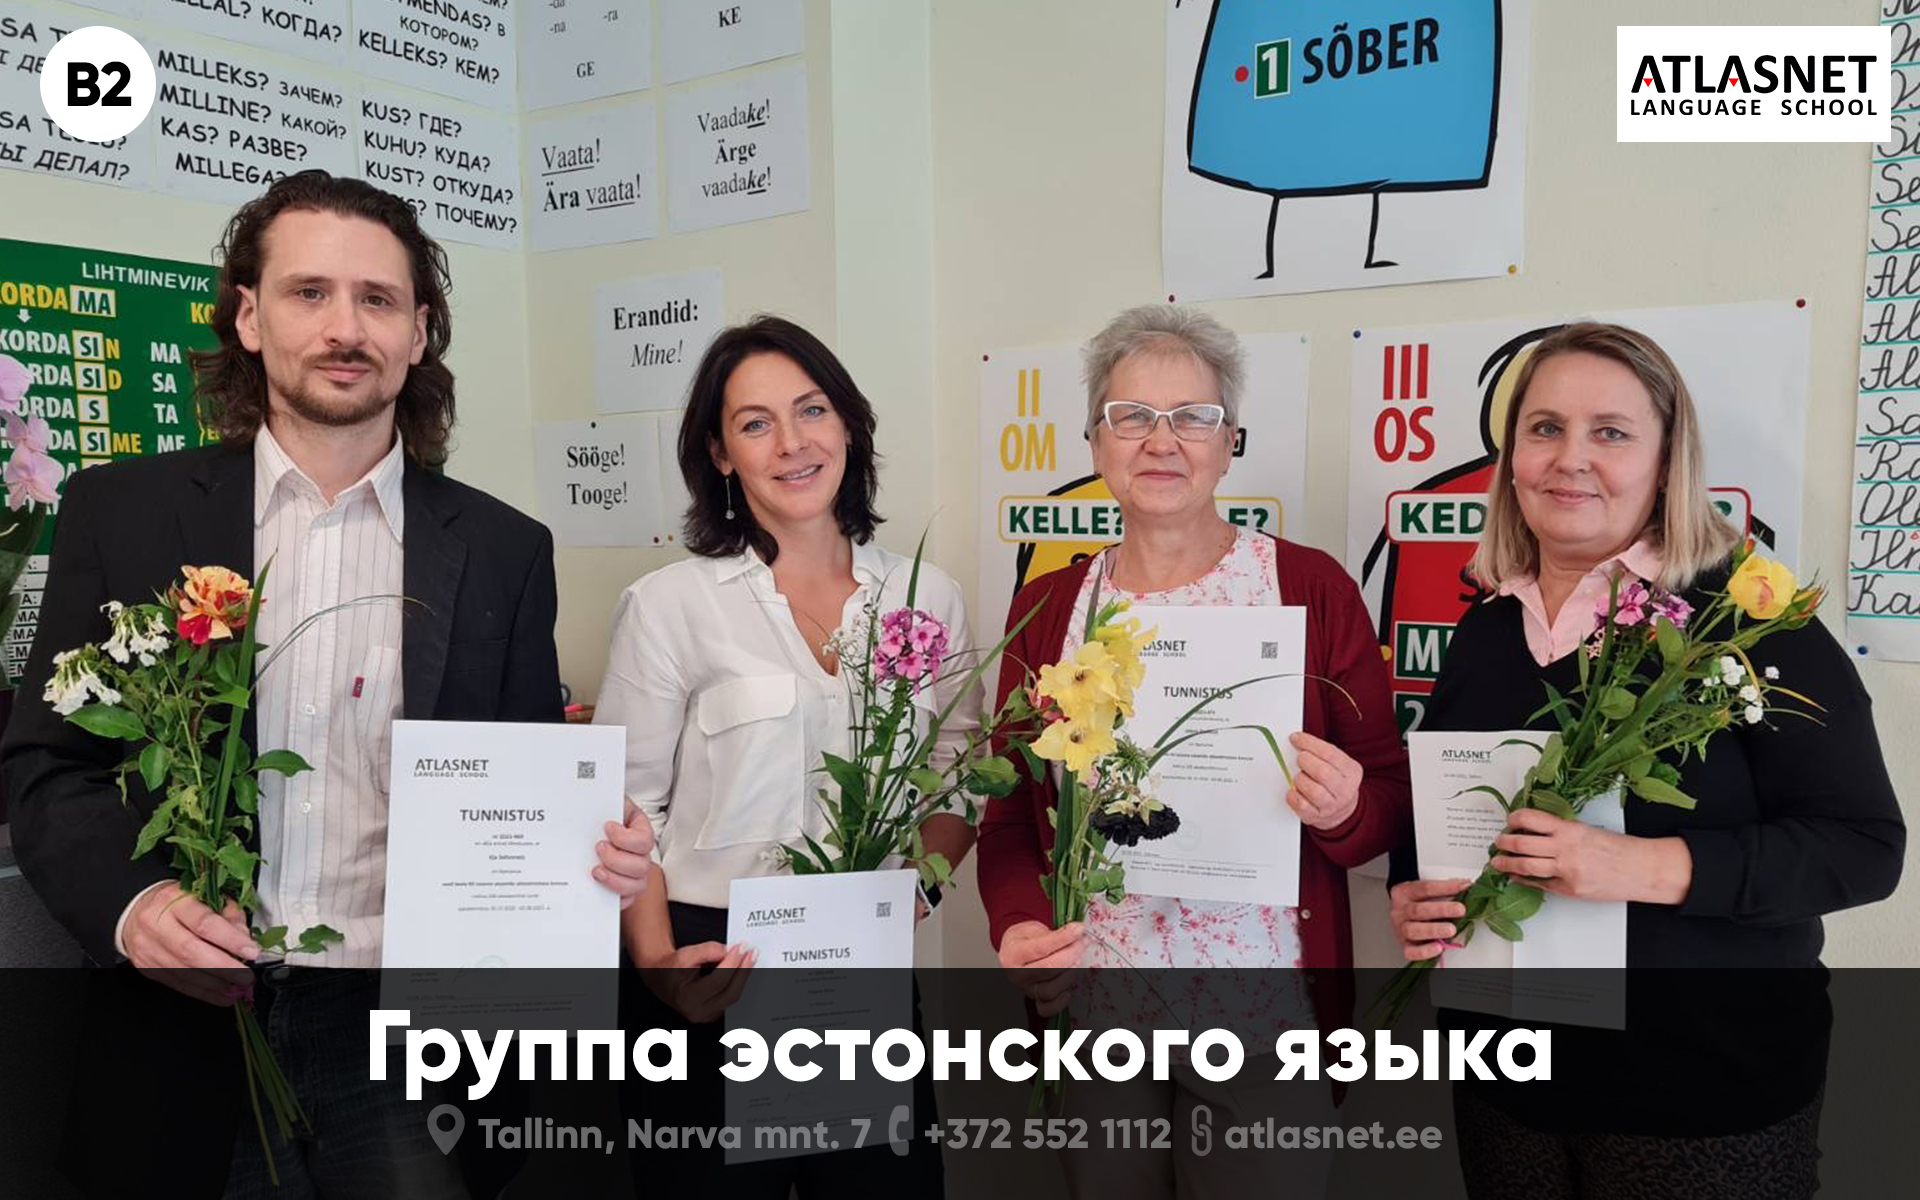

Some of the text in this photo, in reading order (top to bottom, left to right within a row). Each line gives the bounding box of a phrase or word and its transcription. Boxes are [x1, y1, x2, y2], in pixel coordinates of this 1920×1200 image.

[0, 18, 37, 42] SA
[262, 7, 342, 42] КОГДА?
[405, 0, 491, 31] MENDAS?
[718, 6, 742, 28] KE
[400, 16, 479, 51] КОТОРОМ?
[359, 30, 500, 84] KELLEKS? КЕМ?
[576, 61, 595, 78] GE
[1261, 17, 1440, 91] 1 SÕBER
[158, 50, 343, 108] MILLEKS? ЗАЧЕМ?
[160, 84, 347, 139] MILLINE? КАКОЙ?
[362, 100, 462, 137] KUS? ГДЕ?
[697, 98, 770, 132] Vaadake!
[161, 117, 307, 161] KAS? РАЗВЕ?
[364, 131, 491, 173] KUHU? КУДА?
[541, 138, 600, 171] Vaata!
[715, 139, 756, 165] Ärge
[34, 150, 130, 180] ДЕЛАЛ?
[366, 160, 513, 205] KUST? ОТКУДА?
[543, 174, 641, 212] Ära vaata!
[702, 166, 772, 198] vaadake!
[435, 203, 517, 233] ПОЧЕМУ?
[82, 262, 210, 293] LIHTMINEVIK
[0, 281, 111, 315] ORDA MA
[613, 299, 699, 330] Erandid:
[151, 342, 182, 364] MA
[630, 340, 683, 368] Mine!
[28, 363, 73, 387] RDA
[153, 373, 177, 394] SA
[1384, 343, 1430, 400] III
[1018, 369, 1040, 417] II
[153, 403, 178, 424] TA
[1000, 423, 1056, 471] OM
[1374, 406, 1436, 462] OS
[566, 443, 625, 473] Sööge!
[567, 482, 628, 510] Tooge!
[1009, 506, 1124, 535] KELLE?
[1401, 502, 1488, 534] KED
[1164, 686, 1233, 700] TUNNISTUS
[415, 758, 489, 771] ATLASNET
[1441, 749, 1491, 760] ATLASNET
[460, 809, 545, 822] TUNNISTUS
[747, 907, 806, 922] ATLASNET
[782, 947, 851, 962] TUNNISTUS
